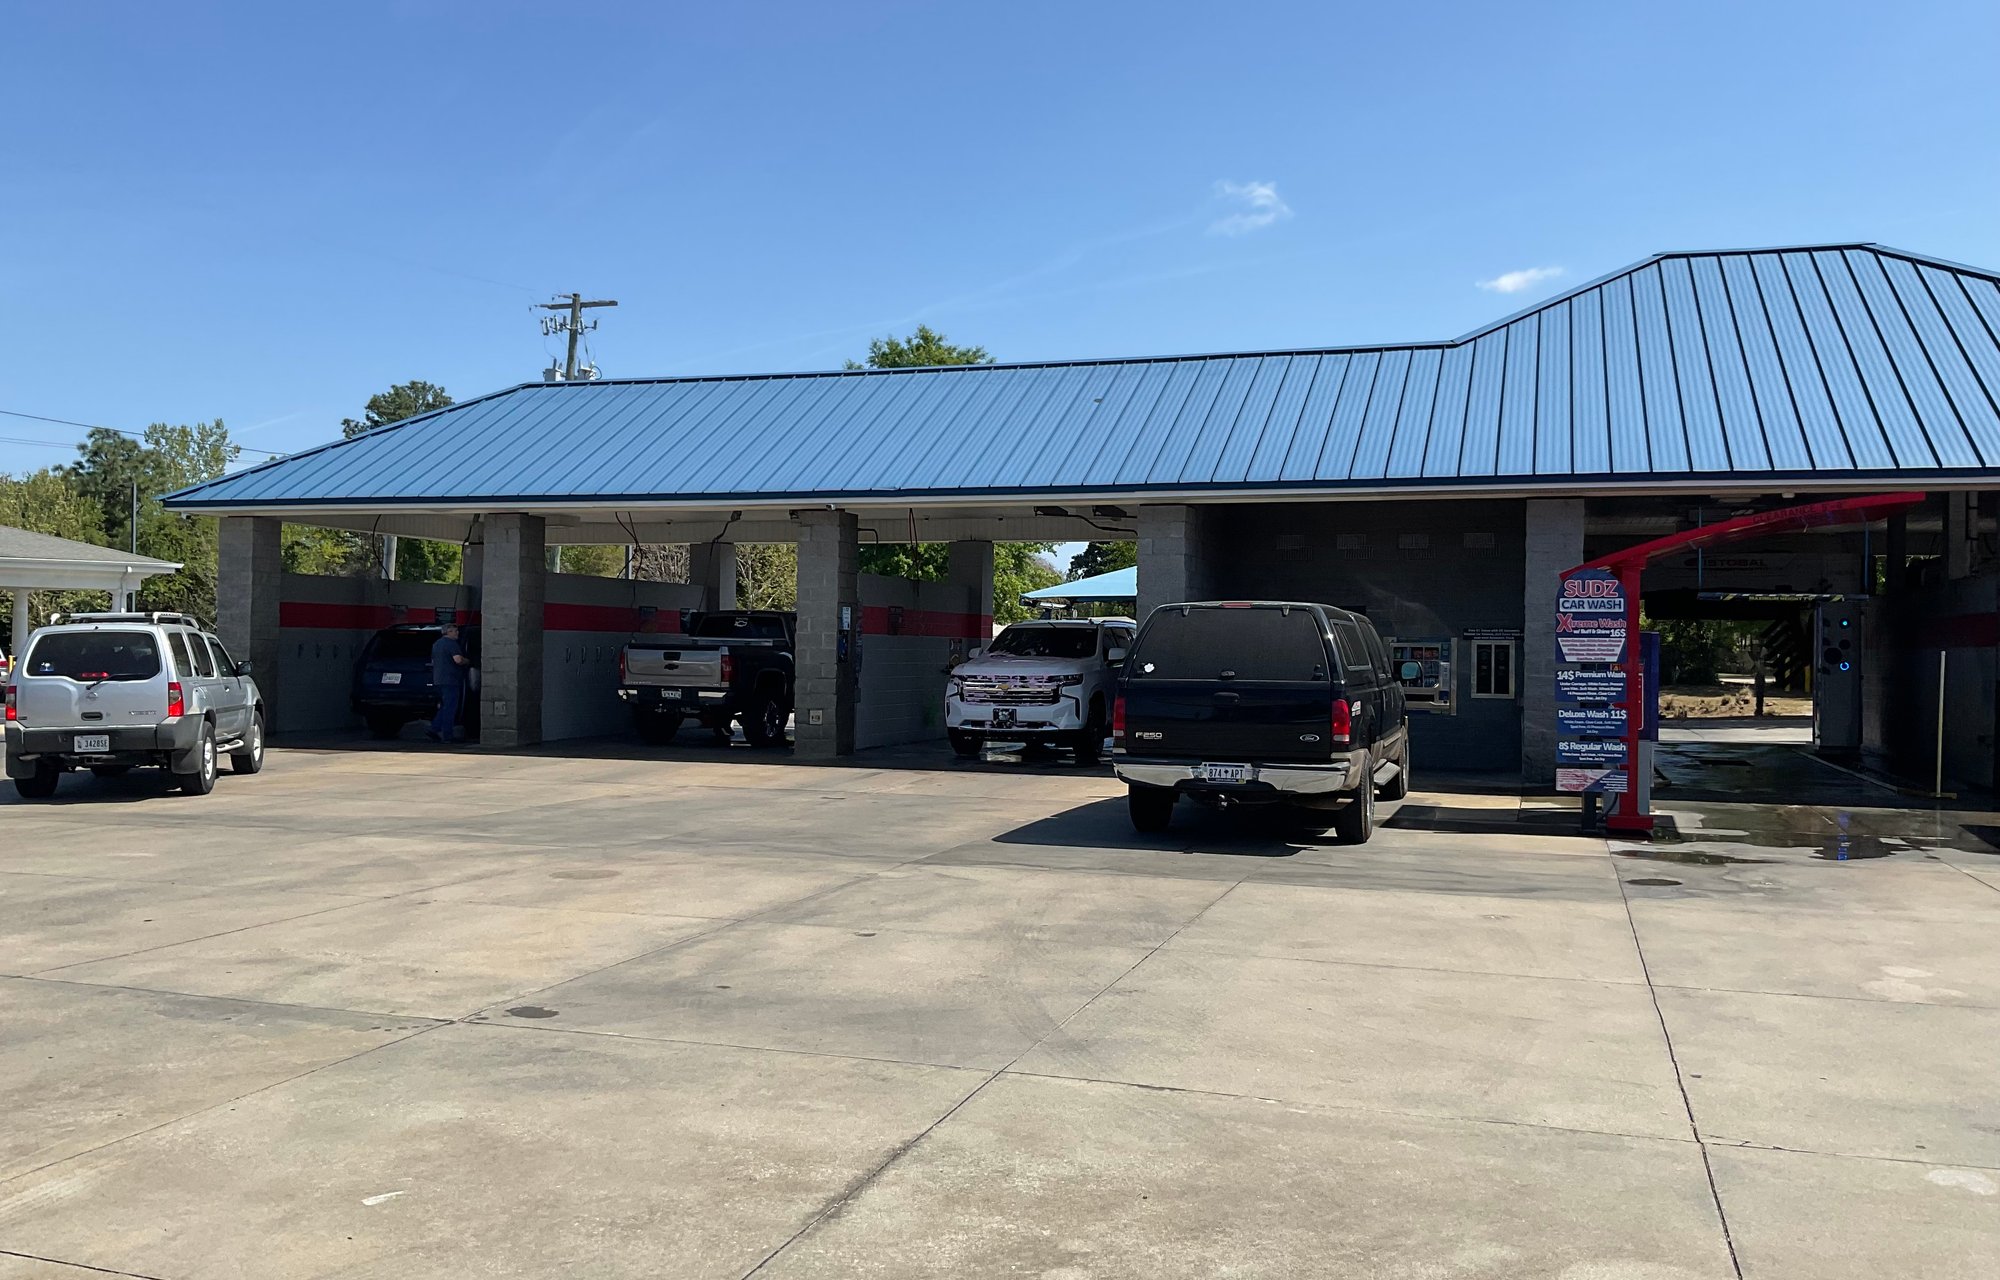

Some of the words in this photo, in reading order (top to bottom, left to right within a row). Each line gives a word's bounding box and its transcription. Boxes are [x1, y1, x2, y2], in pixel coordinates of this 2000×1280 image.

[1752, 504, 1816, 523] CLEARANCE
[1564, 579, 1619, 598] SUDZ
[1561, 600, 1585, 610] CAR
[1587, 600, 1622, 610] WASH
[1556, 613, 1598, 633] Xtreme
[1599, 618, 1627, 628] Wash
[1610, 628, 1626, 638] 16$
[1557, 670, 1574, 681] 14$
[1558, 710, 1586, 718] Deluxe
[1610, 709, 1627, 720] 11$
[1558, 742, 1569, 751] 8$
[1570, 742, 1602, 752] Regular
[1603, 742, 1626, 751] Wash
[1208, 768, 1222, 777] 874
[1230, 768, 1244, 778] APT
